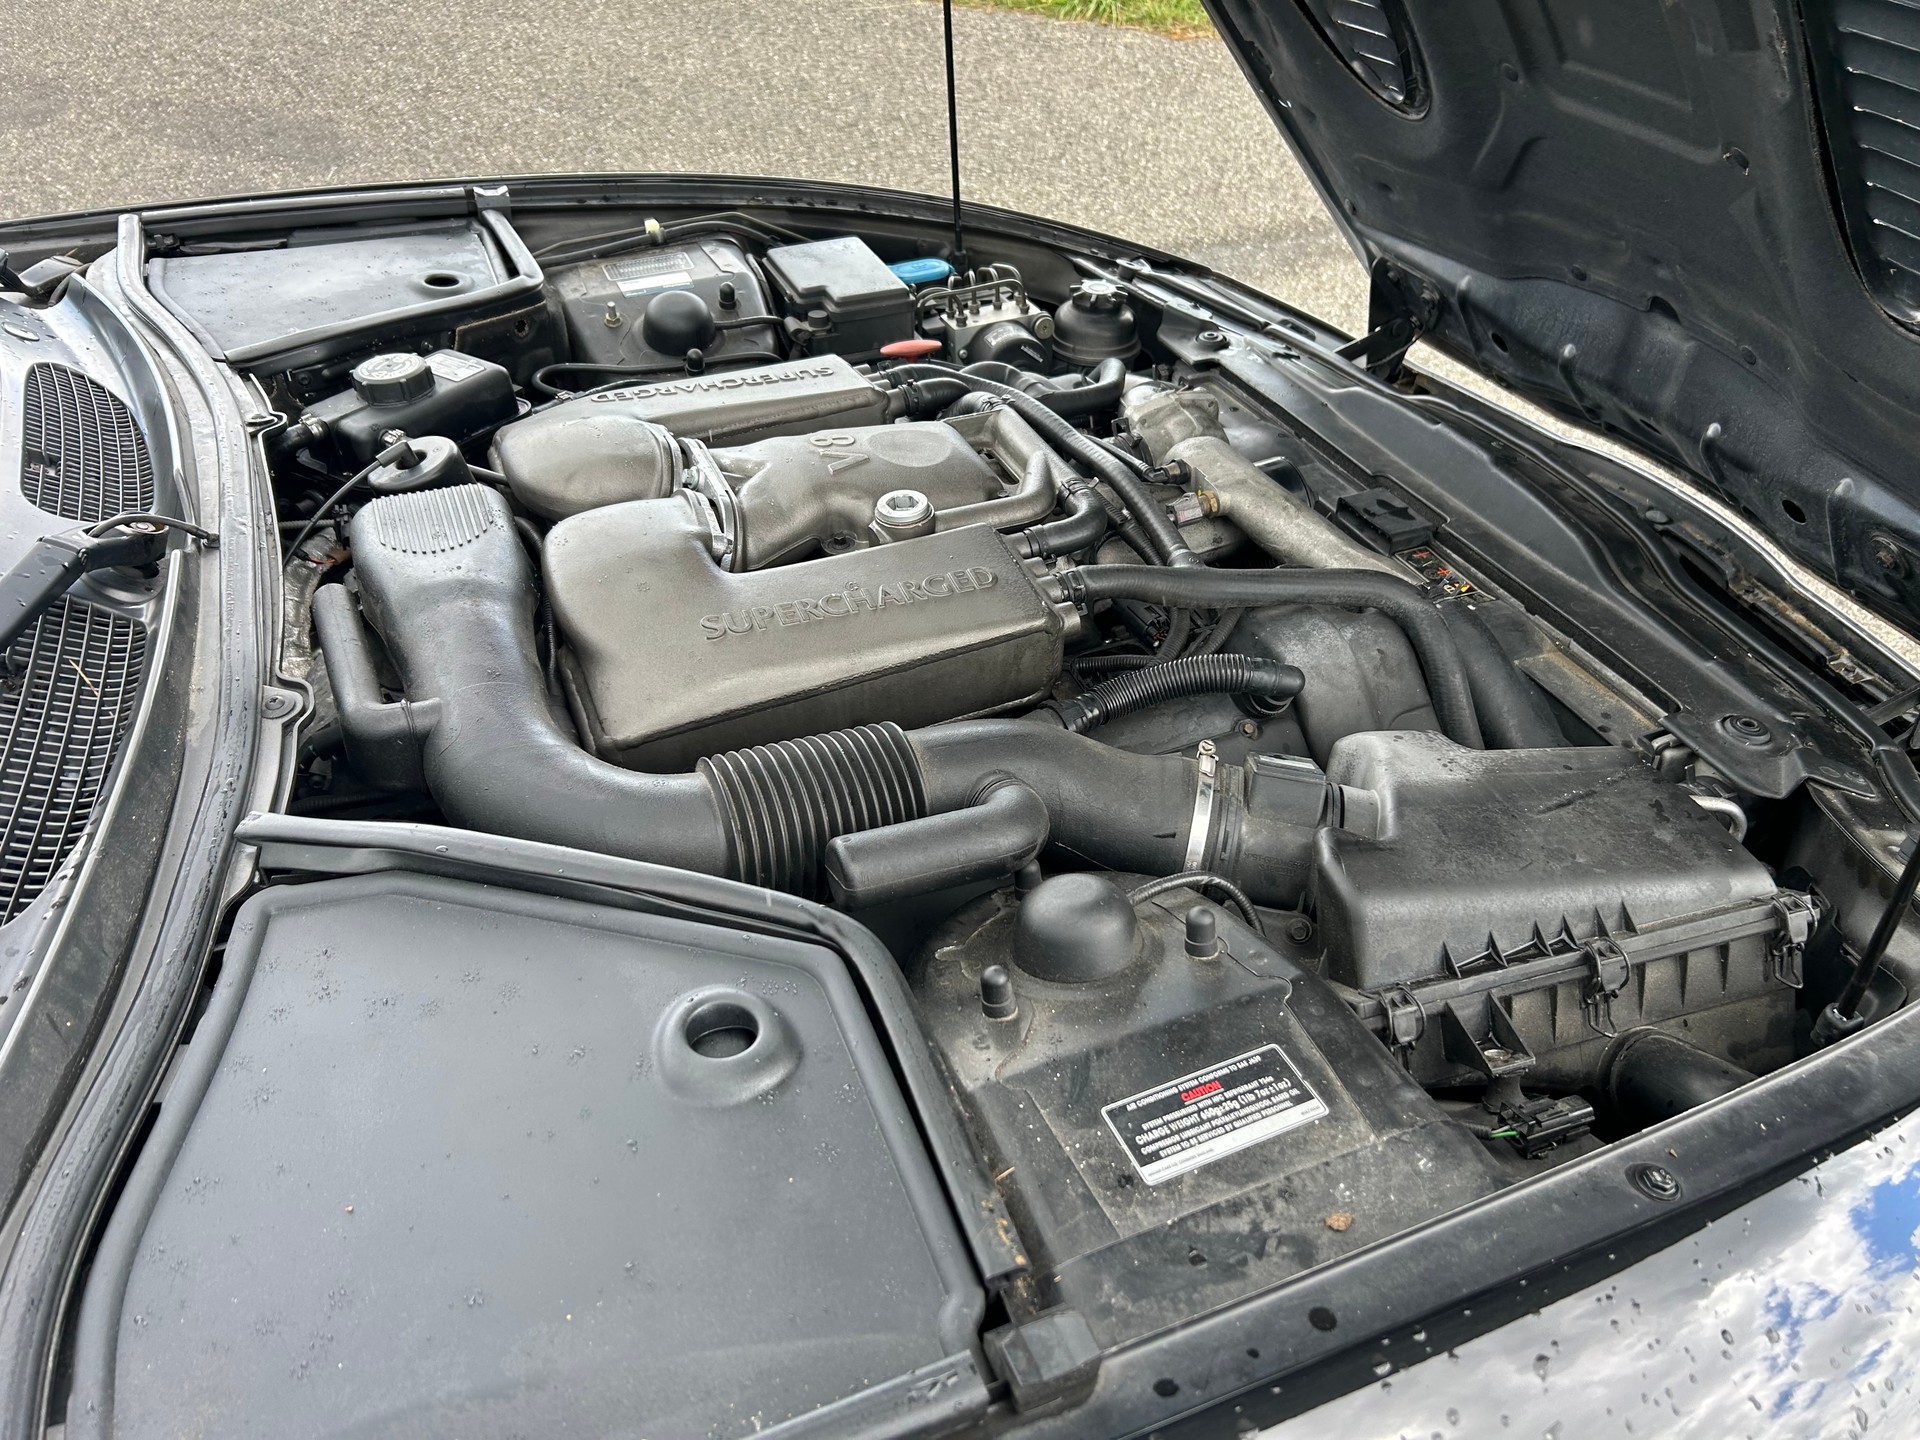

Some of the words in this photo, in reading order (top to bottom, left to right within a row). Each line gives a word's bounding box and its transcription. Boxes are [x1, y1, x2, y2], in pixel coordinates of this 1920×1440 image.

[591, 367, 835, 403] SUPERCHARGED
[809, 434, 871, 475] V8
[700, 566, 998, 641] SUPERCHARGED
[1126, 1102, 1137, 1111] AIR
[1136, 1087, 1178, 1107] CONDITIONING
[1177, 1079, 1199, 1091] SYSTEM
[1198, 1067, 1230, 1083] CONFORMS
[1228, 1064, 1238, 1072] TO
[1236, 1060, 1248, 1069] SAE
[1248, 1055, 1261, 1065] J639
[1141, 1117, 1164, 1131] SYSTEM
[1196, 1098, 1213, 1109] WITH
[1211, 1094, 1225, 1103] HFC
[1223, 1080, 1259, 1099] REFRIGERANT
[1181, 1080, 1223, 1103] CAUTION
[1135, 1125, 1171, 1145] CHARGE
[1168, 1113, 1200, 1131] WEIGHT
[1200, 1100, 1240, 1120] 650g±25g
[1141, 1134, 1181, 1155] COMPRESSOR
[1179, 1122, 1212, 1140] LUBRICANT
[1270, 1091, 1290, 1104] BASED
[1288, 1088, 1301, 1096] OIL
[1159, 1144, 1182, 1157] SYSTEM
[1180, 1140, 1191, 1149] TO
[1189, 1137, 1198, 1146] BE
[1197, 1127, 1226, 1142] SERVICED
[1224, 1123, 1233, 1132] BY
[1232, 1112, 1262, 1128] QUALIFIED
[1260, 1100, 1294, 1117] PERSONNEL
